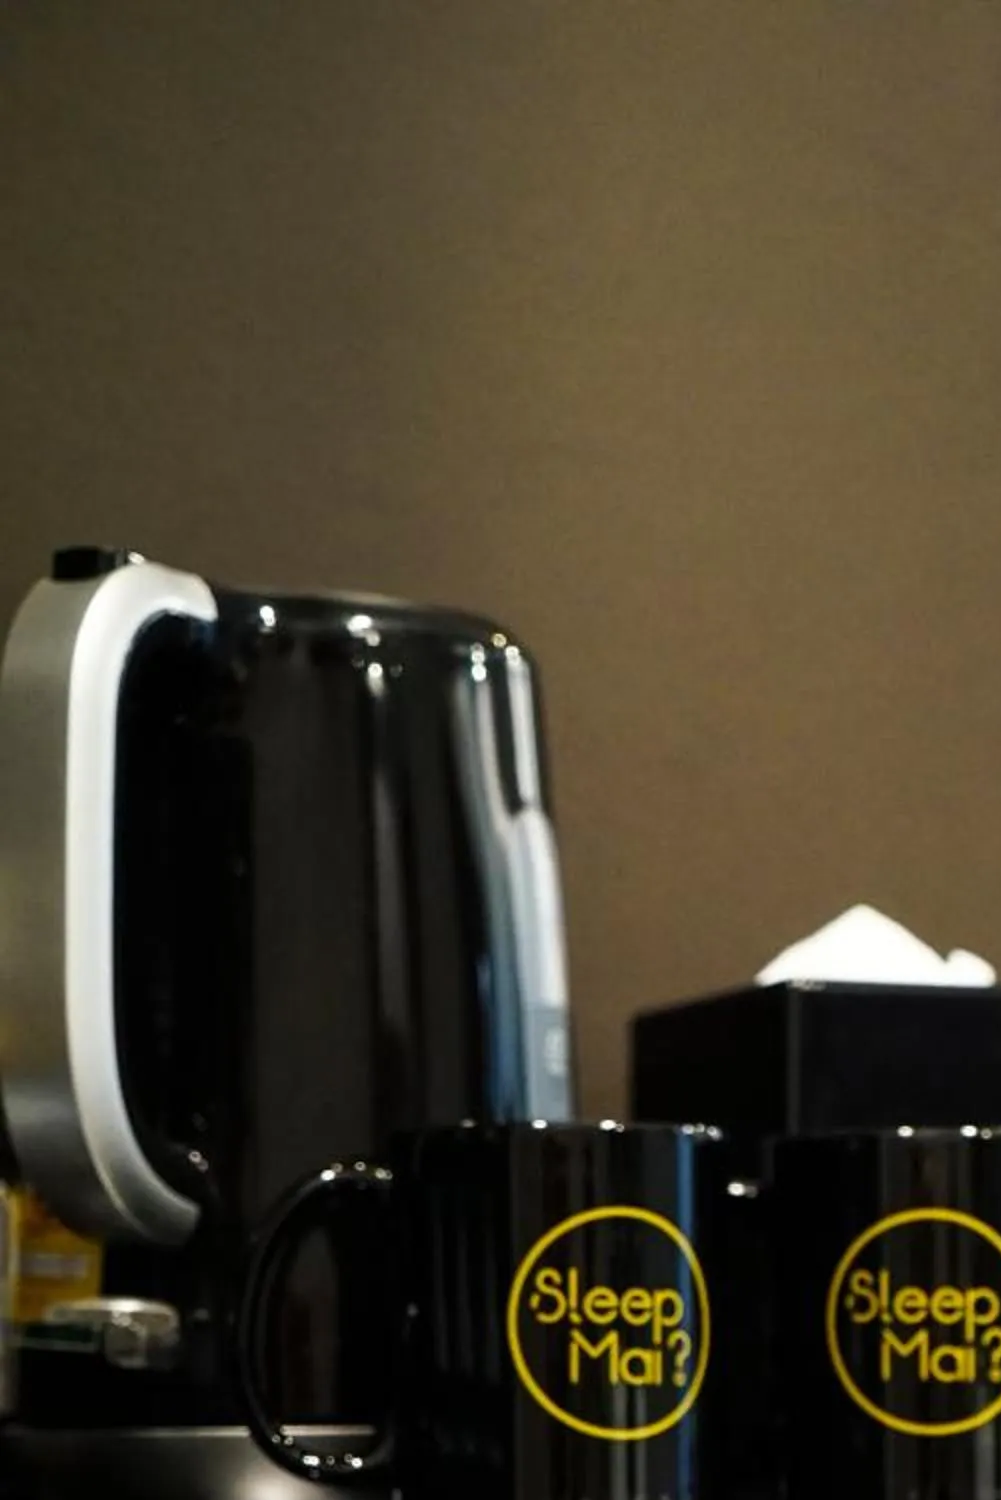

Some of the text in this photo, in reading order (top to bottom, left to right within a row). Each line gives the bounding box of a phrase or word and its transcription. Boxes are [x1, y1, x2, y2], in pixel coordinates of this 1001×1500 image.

[531, 1266, 685, 1326] Sleep
[846, 1269, 1001, 1328] Sleep
[569, 1328, 692, 1386] Mai?
